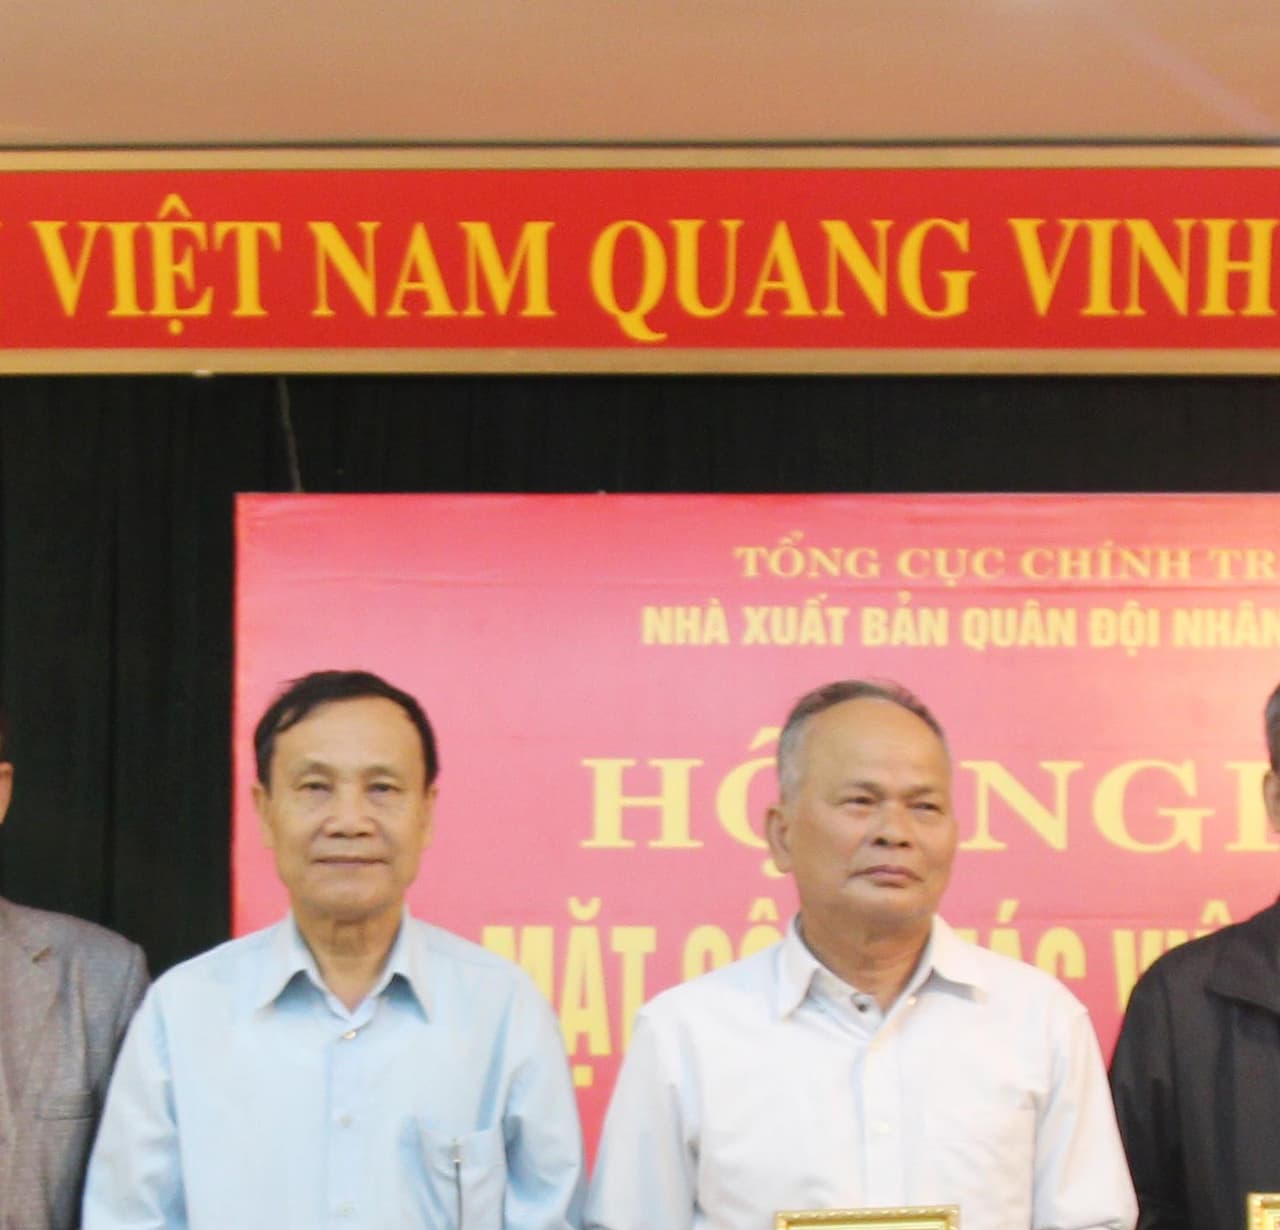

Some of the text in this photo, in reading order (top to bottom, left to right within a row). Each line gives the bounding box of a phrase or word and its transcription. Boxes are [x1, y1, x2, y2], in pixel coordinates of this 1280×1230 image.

[30, 194, 281, 334] VIỆT
[308, 221, 555, 316] NAM
[590, 218, 975, 341] QUANG
[1008, 218, 1279, 317] VINH
[734, 530, 880, 581] TỔNG
[896, 547, 1004, 588] CỤC
[1021, 540, 1192, 580] CHÍNH
[641, 598, 730, 646] NHÀ
[742, 592, 847, 647] XUẤT
[861, 591, 949, 647] BẢN
[962, 600, 1077, 651] QUÂN
[1088, 600, 1160, 656] ĐỘI
